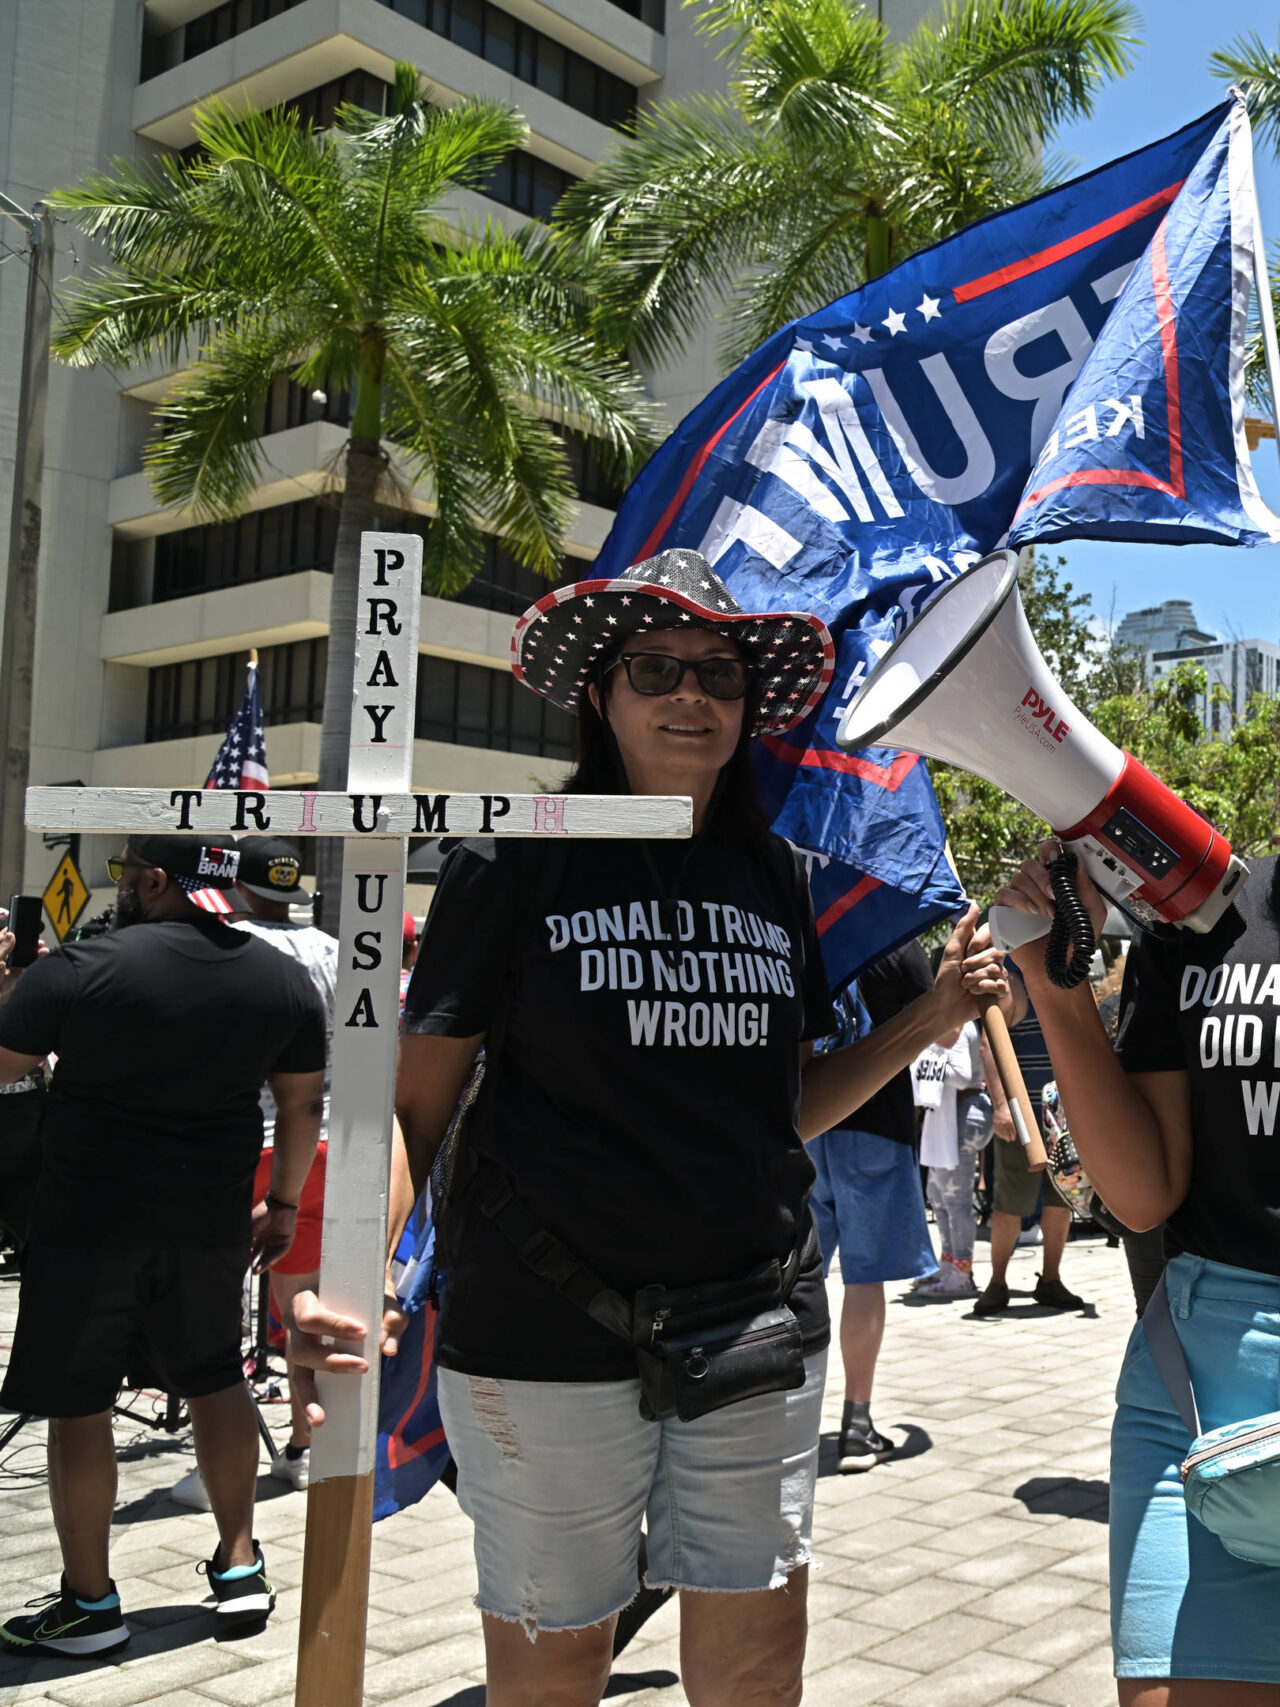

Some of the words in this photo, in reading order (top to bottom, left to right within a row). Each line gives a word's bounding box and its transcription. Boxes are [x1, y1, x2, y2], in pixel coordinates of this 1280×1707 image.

[364, 549, 404, 743] PRAY
[1012, 706, 1056, 754] PyleUSA.com
[170, 790, 568, 834] TRIUMPH
[345, 874, 388, 1029] USA
[545, 900, 695, 952] DONALD
[702, 902, 792, 959] TRUMP
[580, 948, 644, 992] DID
[650, 949, 796, 998] NOTHING
[627, 1000, 769, 1047] WRONG!
[1200, 1014, 1263, 1070] DID
